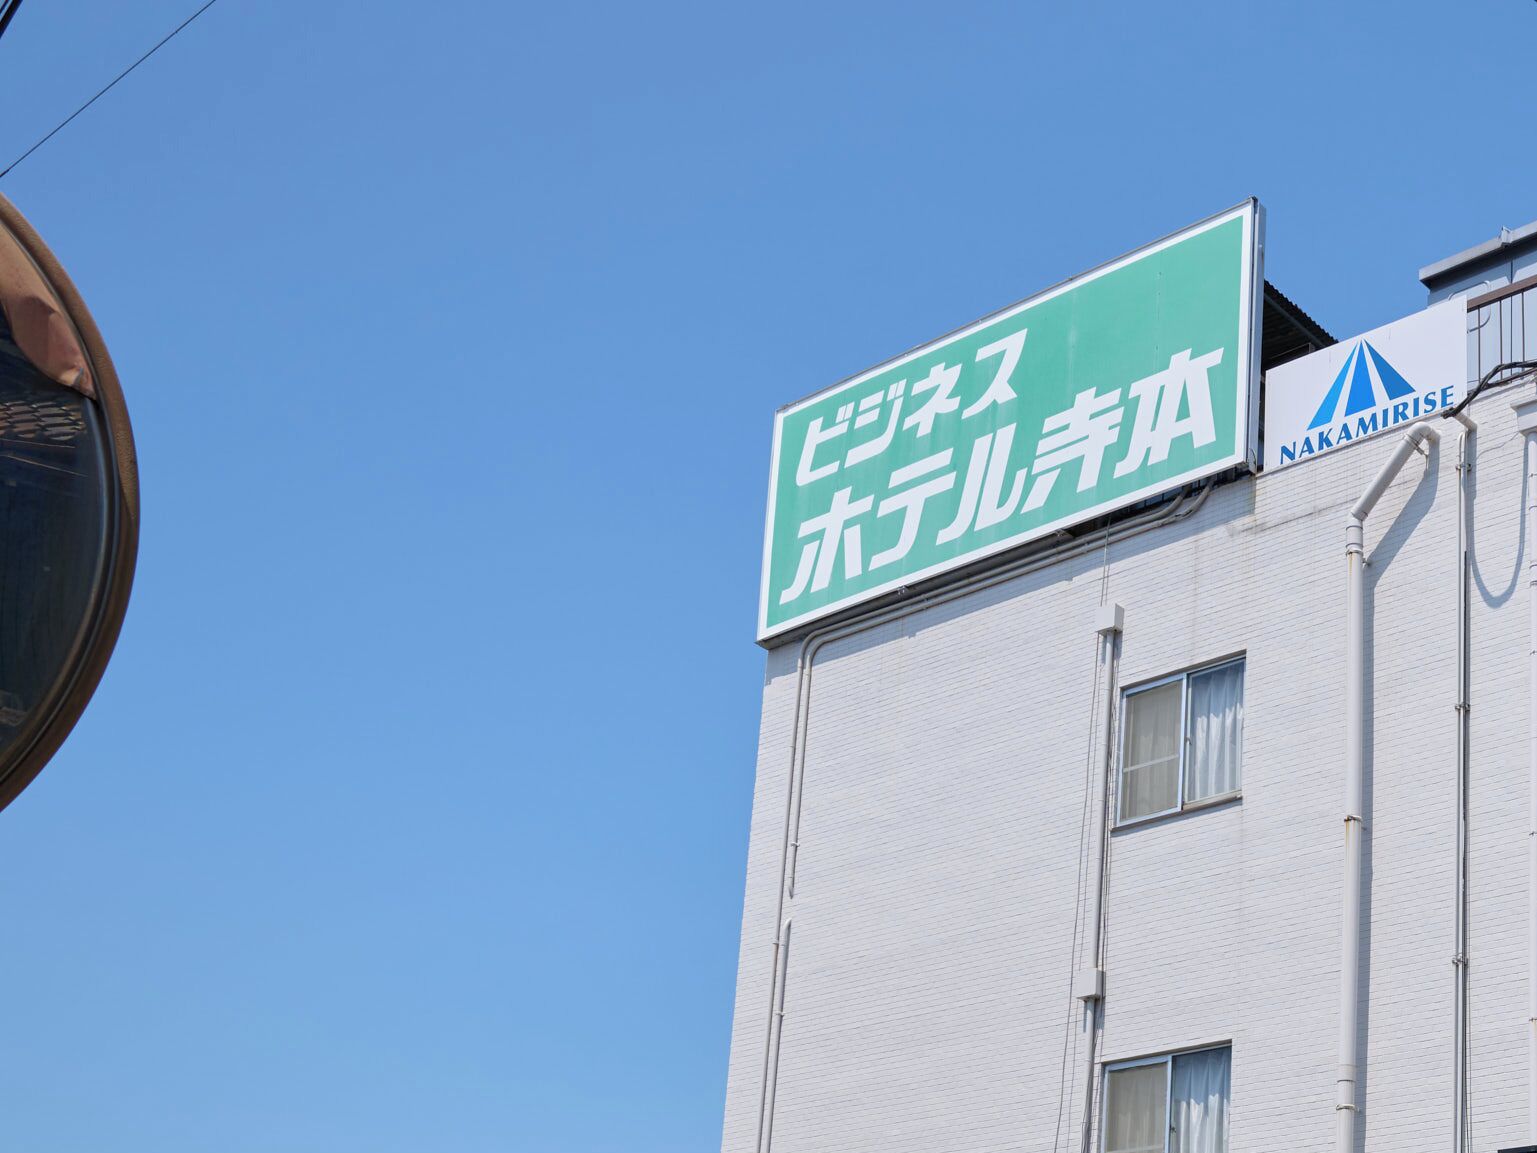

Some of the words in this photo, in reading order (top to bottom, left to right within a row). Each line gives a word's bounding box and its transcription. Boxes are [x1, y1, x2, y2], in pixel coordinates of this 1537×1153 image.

[780, 348, 1224, 604] ホテル寺本
[796, 329, 1027, 486] ビジネス
[1280, 385, 1454, 464] NAKAMIRISE
